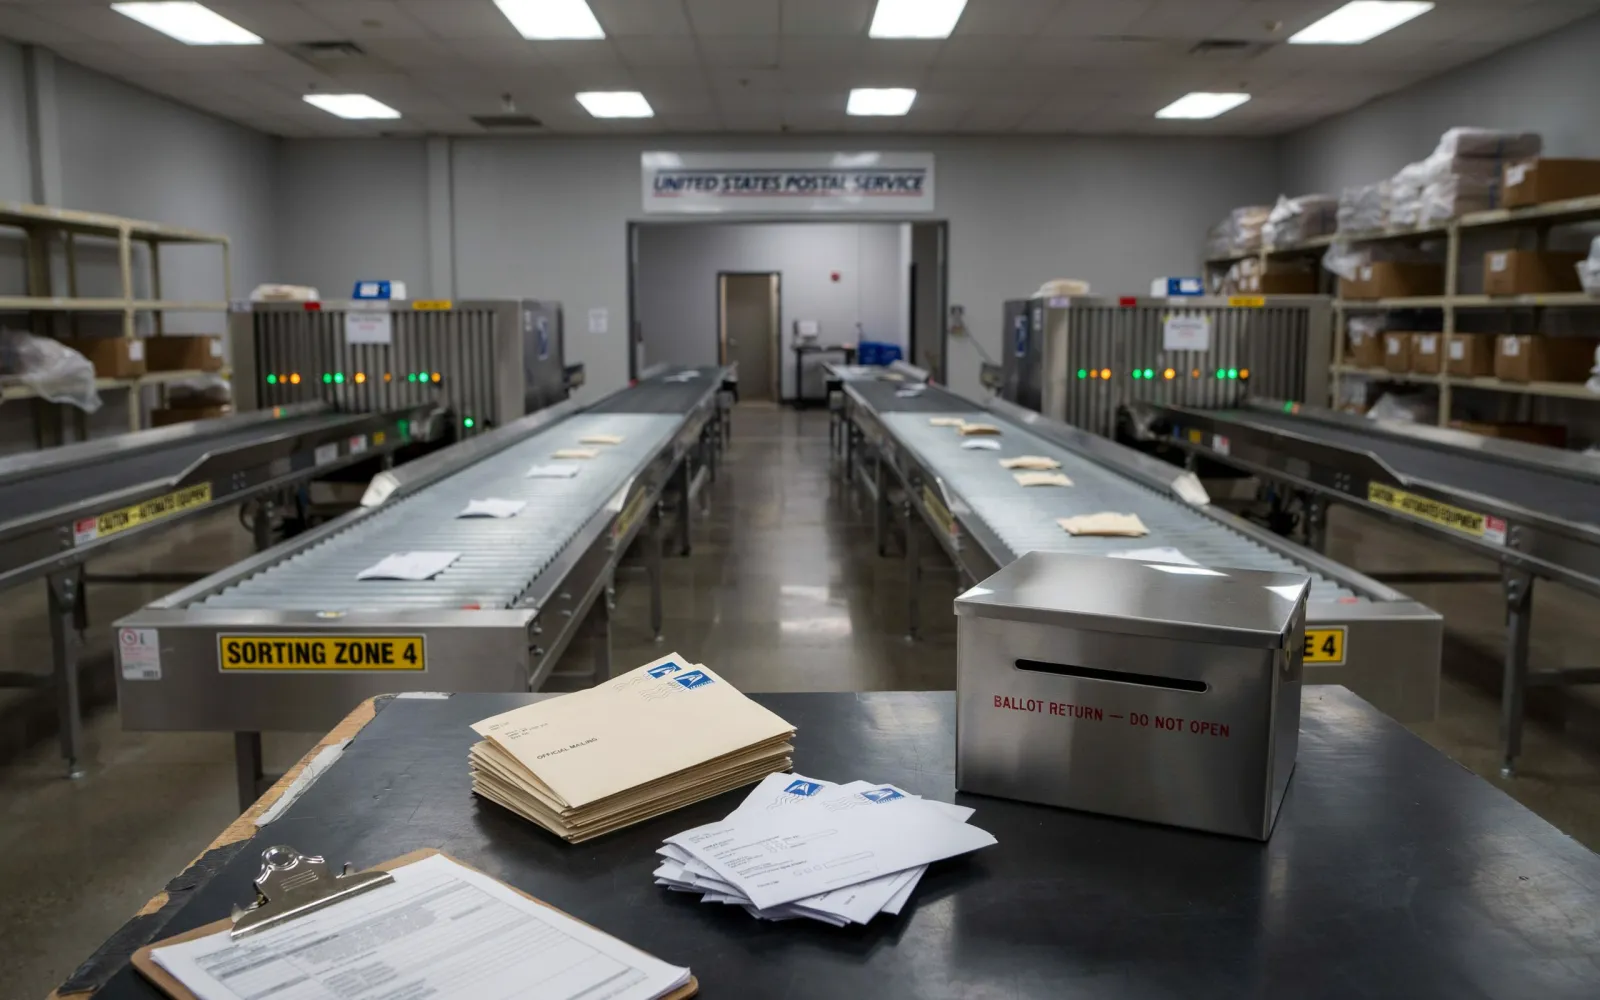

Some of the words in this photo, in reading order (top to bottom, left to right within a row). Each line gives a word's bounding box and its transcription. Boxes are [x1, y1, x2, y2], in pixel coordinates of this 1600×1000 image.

[654, 176, 719, 190] UNITED
[721, 176, 781, 190] STATES
[786, 175, 847, 190] POSTAL
[856, 175, 925, 190] SERVICE
[227, 641, 326, 665] SORTING
[334, 642, 394, 664] ZONE
[403, 643, 417, 664] 4
[1322, 634, 1336, 657] 4
[994, 695, 1044, 713] BALLOT
[1049, 701, 1103, 721] RETURN
[1130, 712, 1149, 727] DO
[1155, 715, 1184, 731] NOT
[1190, 720, 1229, 737] OPEN
[536, 747, 570, 760] OFFICIAL
[569, 736, 598, 750] MAILING
